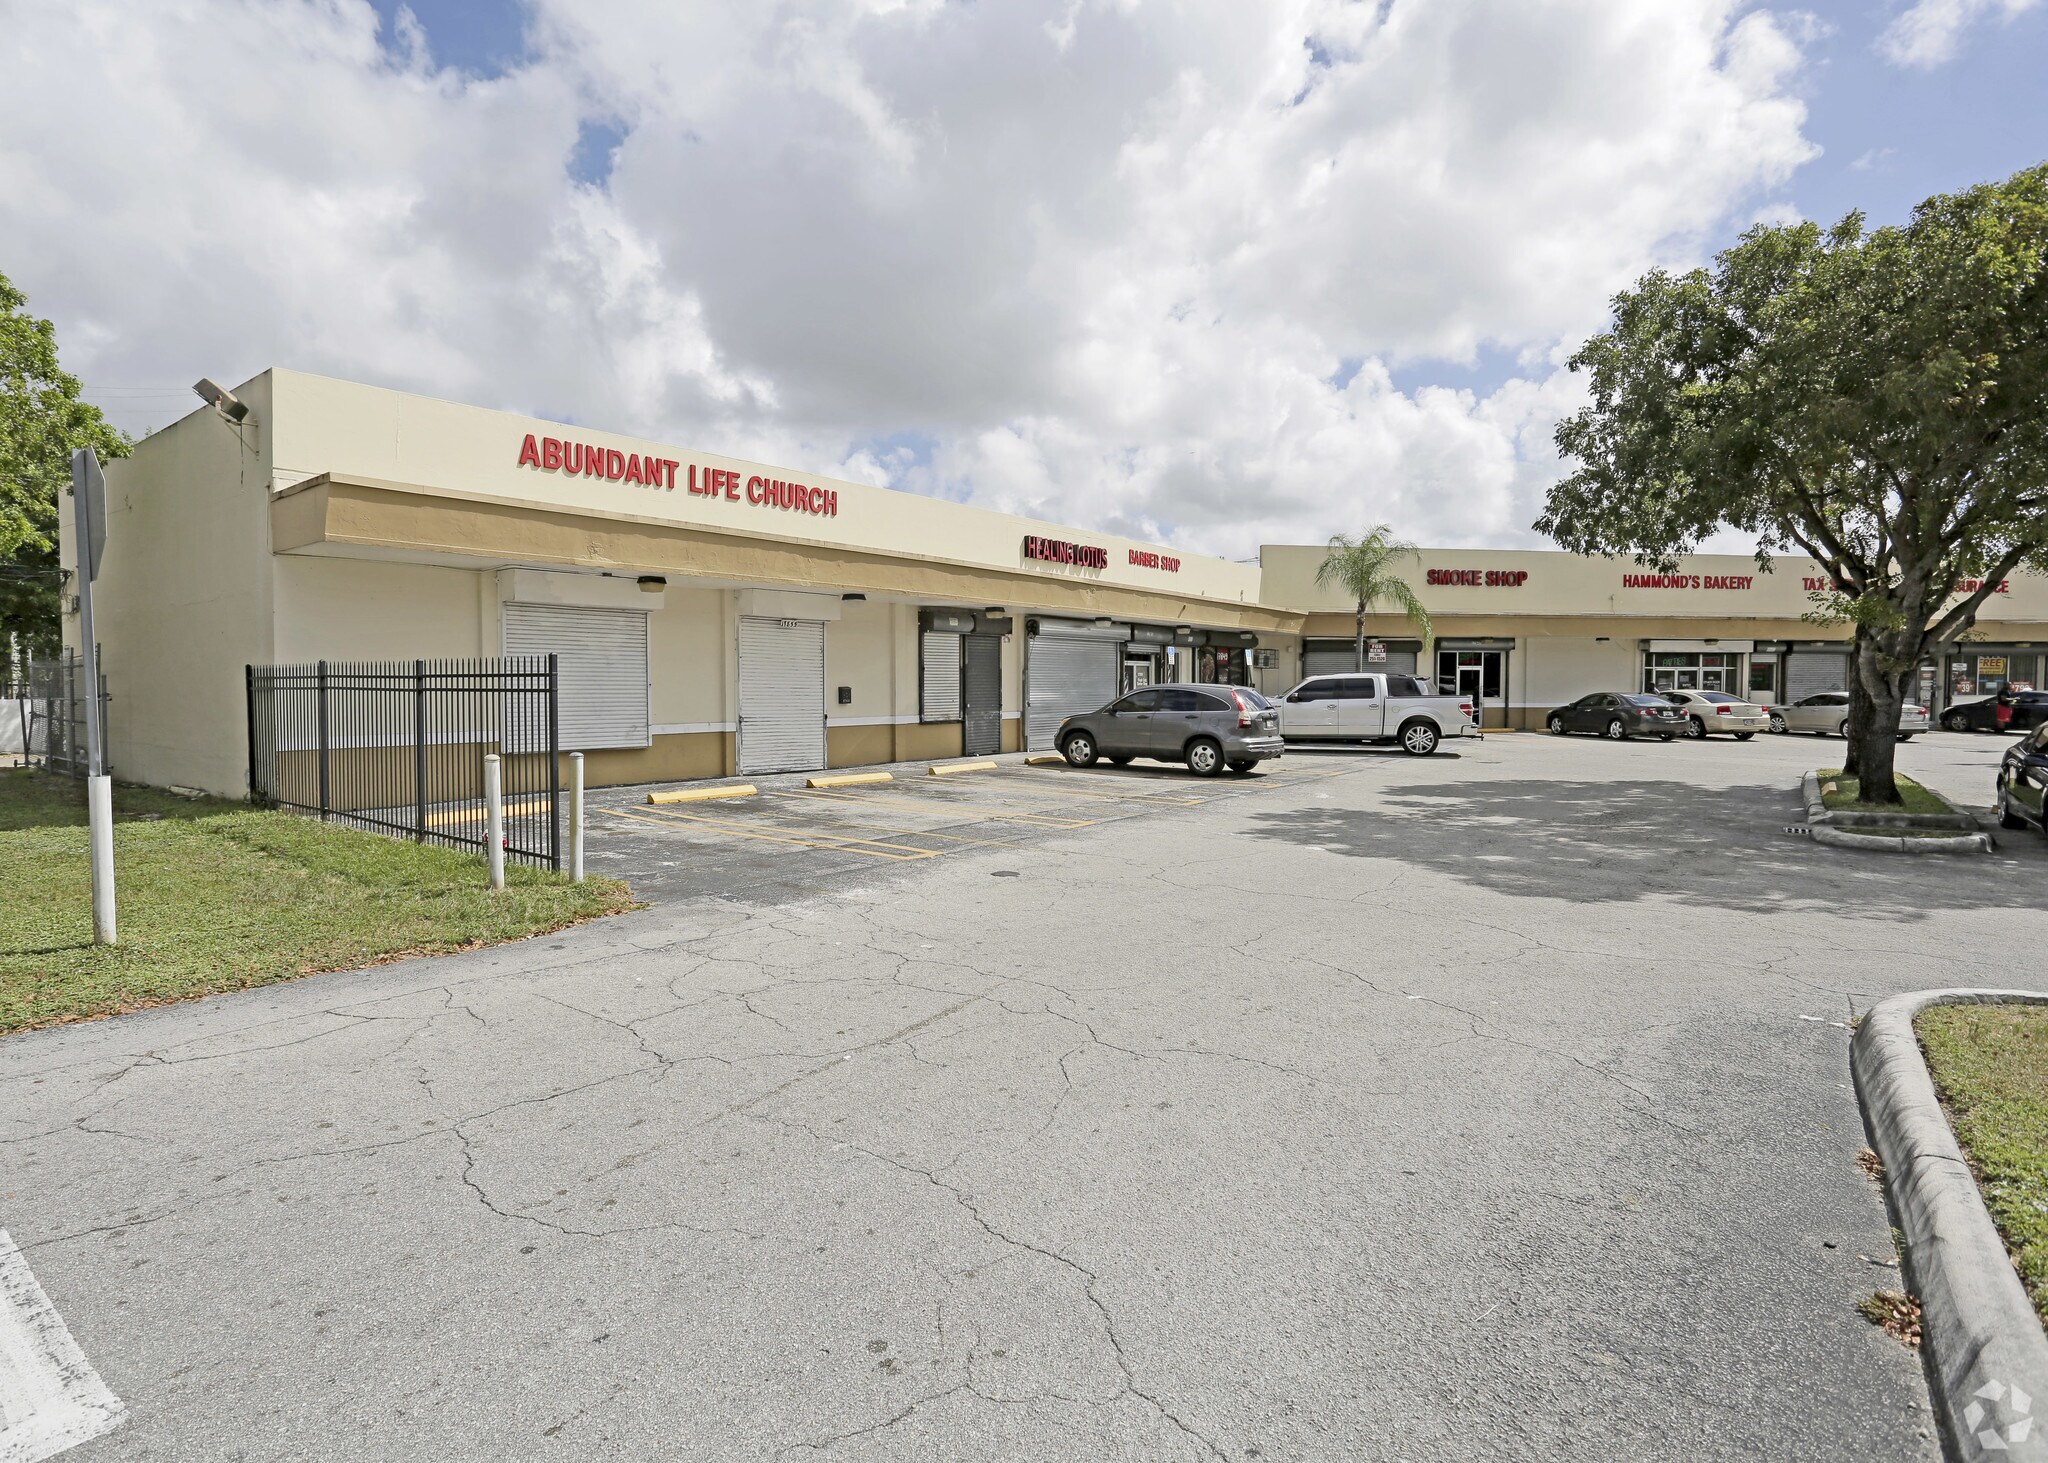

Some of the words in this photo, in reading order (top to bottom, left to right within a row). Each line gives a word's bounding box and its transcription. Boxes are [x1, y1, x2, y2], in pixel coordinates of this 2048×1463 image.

[519, 434, 679, 489] ABUNDANT
[689, 464, 740, 501] LIFE
[748, 475, 838, 516] CHURCH
[1025, 535, 1074, 564] HEALING
[1075, 545, 1108, 569] LOTUS
[1129, 549, 1159, 569] BARBER
[1160, 556, 1181, 573] SHOP
[1427, 569, 1482, 586] SMOKE
[1485, 570, 1528, 587] SHOP
[1623, 574, 1700, 589] HAMMOND'S
[1704, 576, 1753, 590] BAKERY
[1802, 577, 1825, 591] TAX
[1979, 658, 2002, 667] FREE
